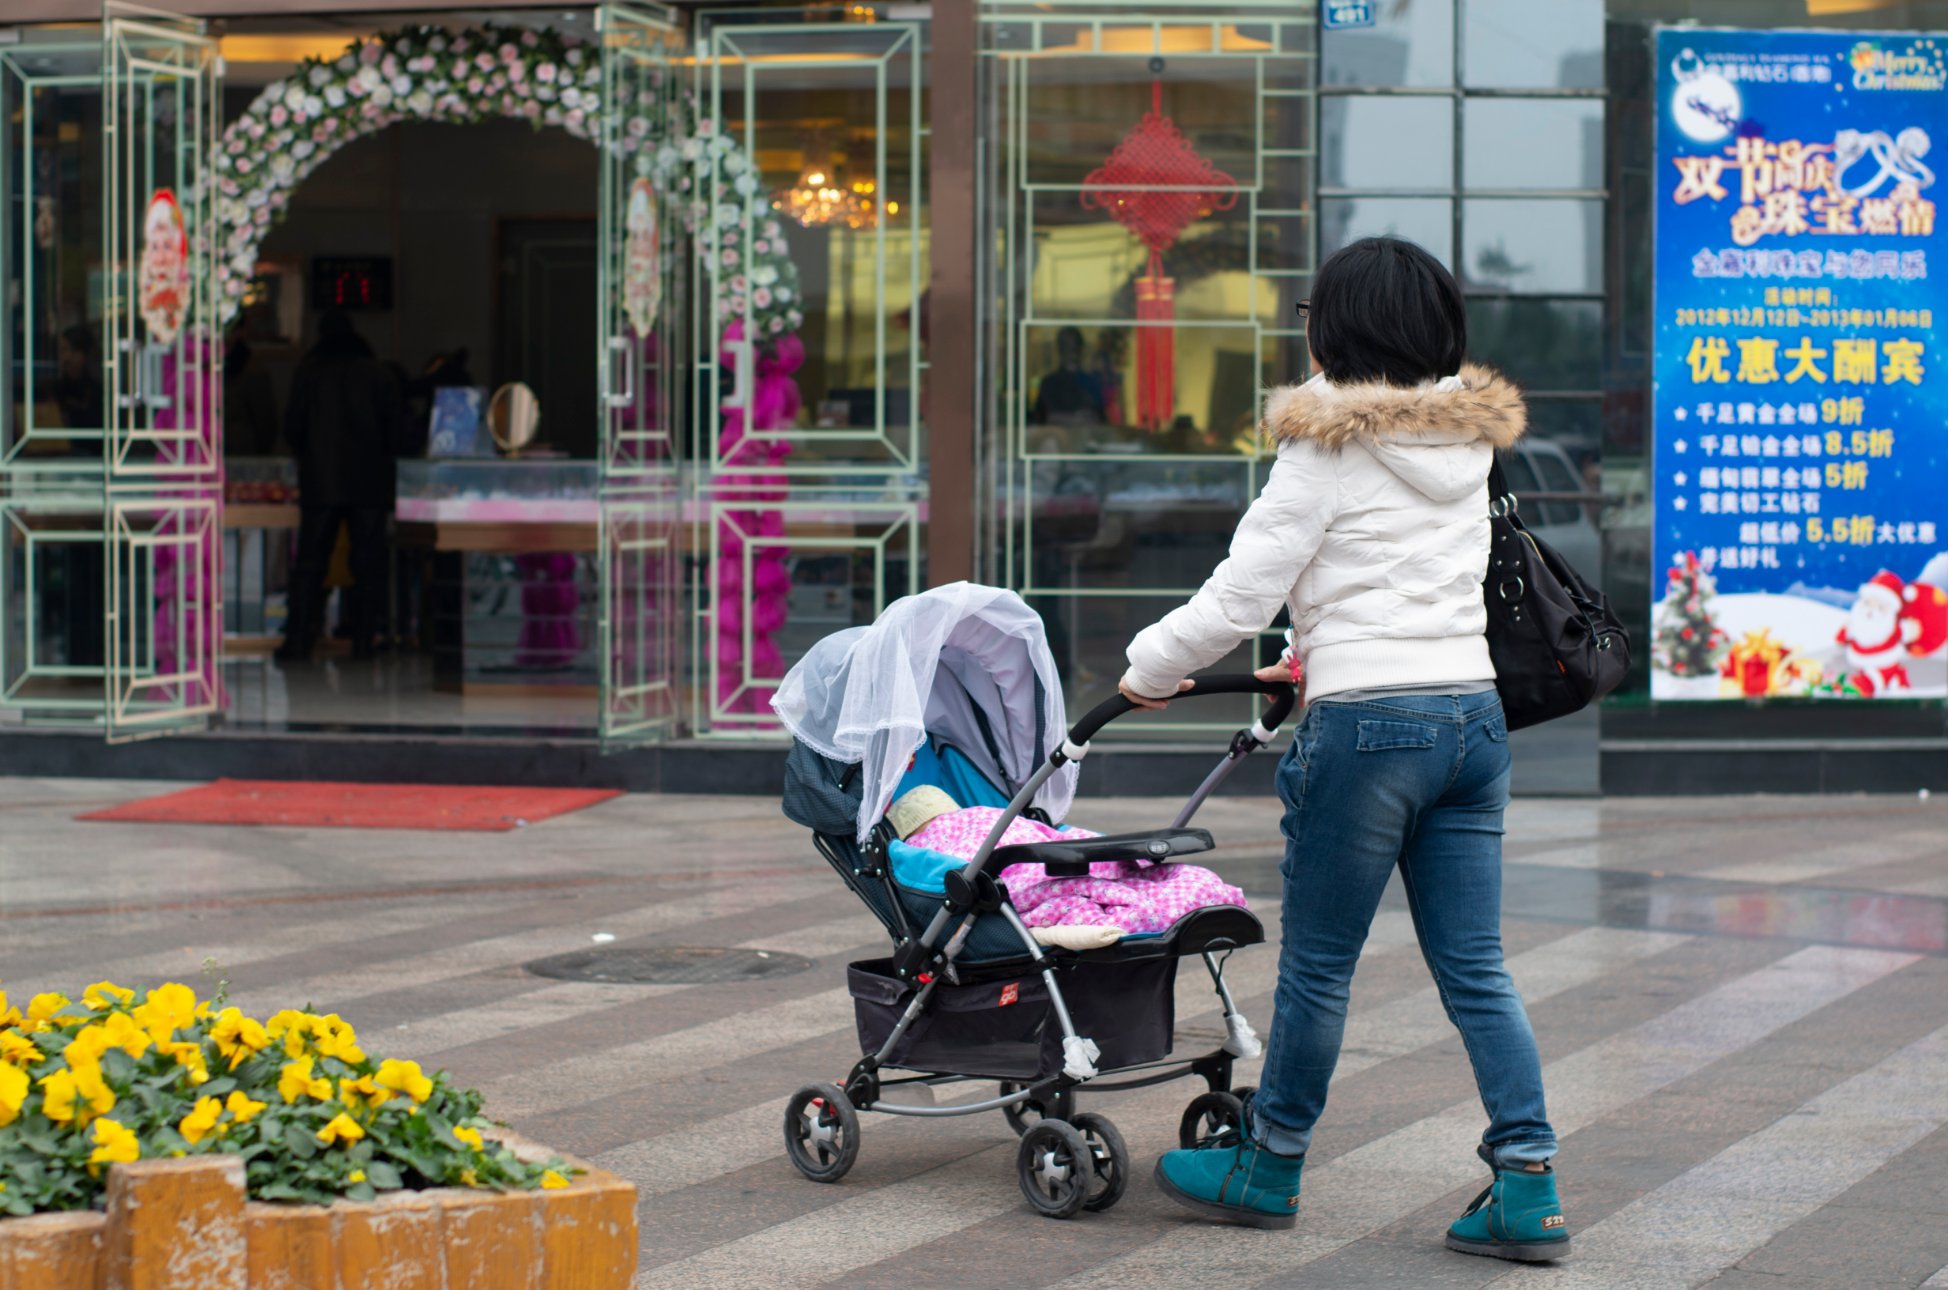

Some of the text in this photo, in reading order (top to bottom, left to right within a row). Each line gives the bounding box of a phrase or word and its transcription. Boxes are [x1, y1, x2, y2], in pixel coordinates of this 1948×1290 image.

[1686, 336, 1925, 385] 优惠大酬宾
